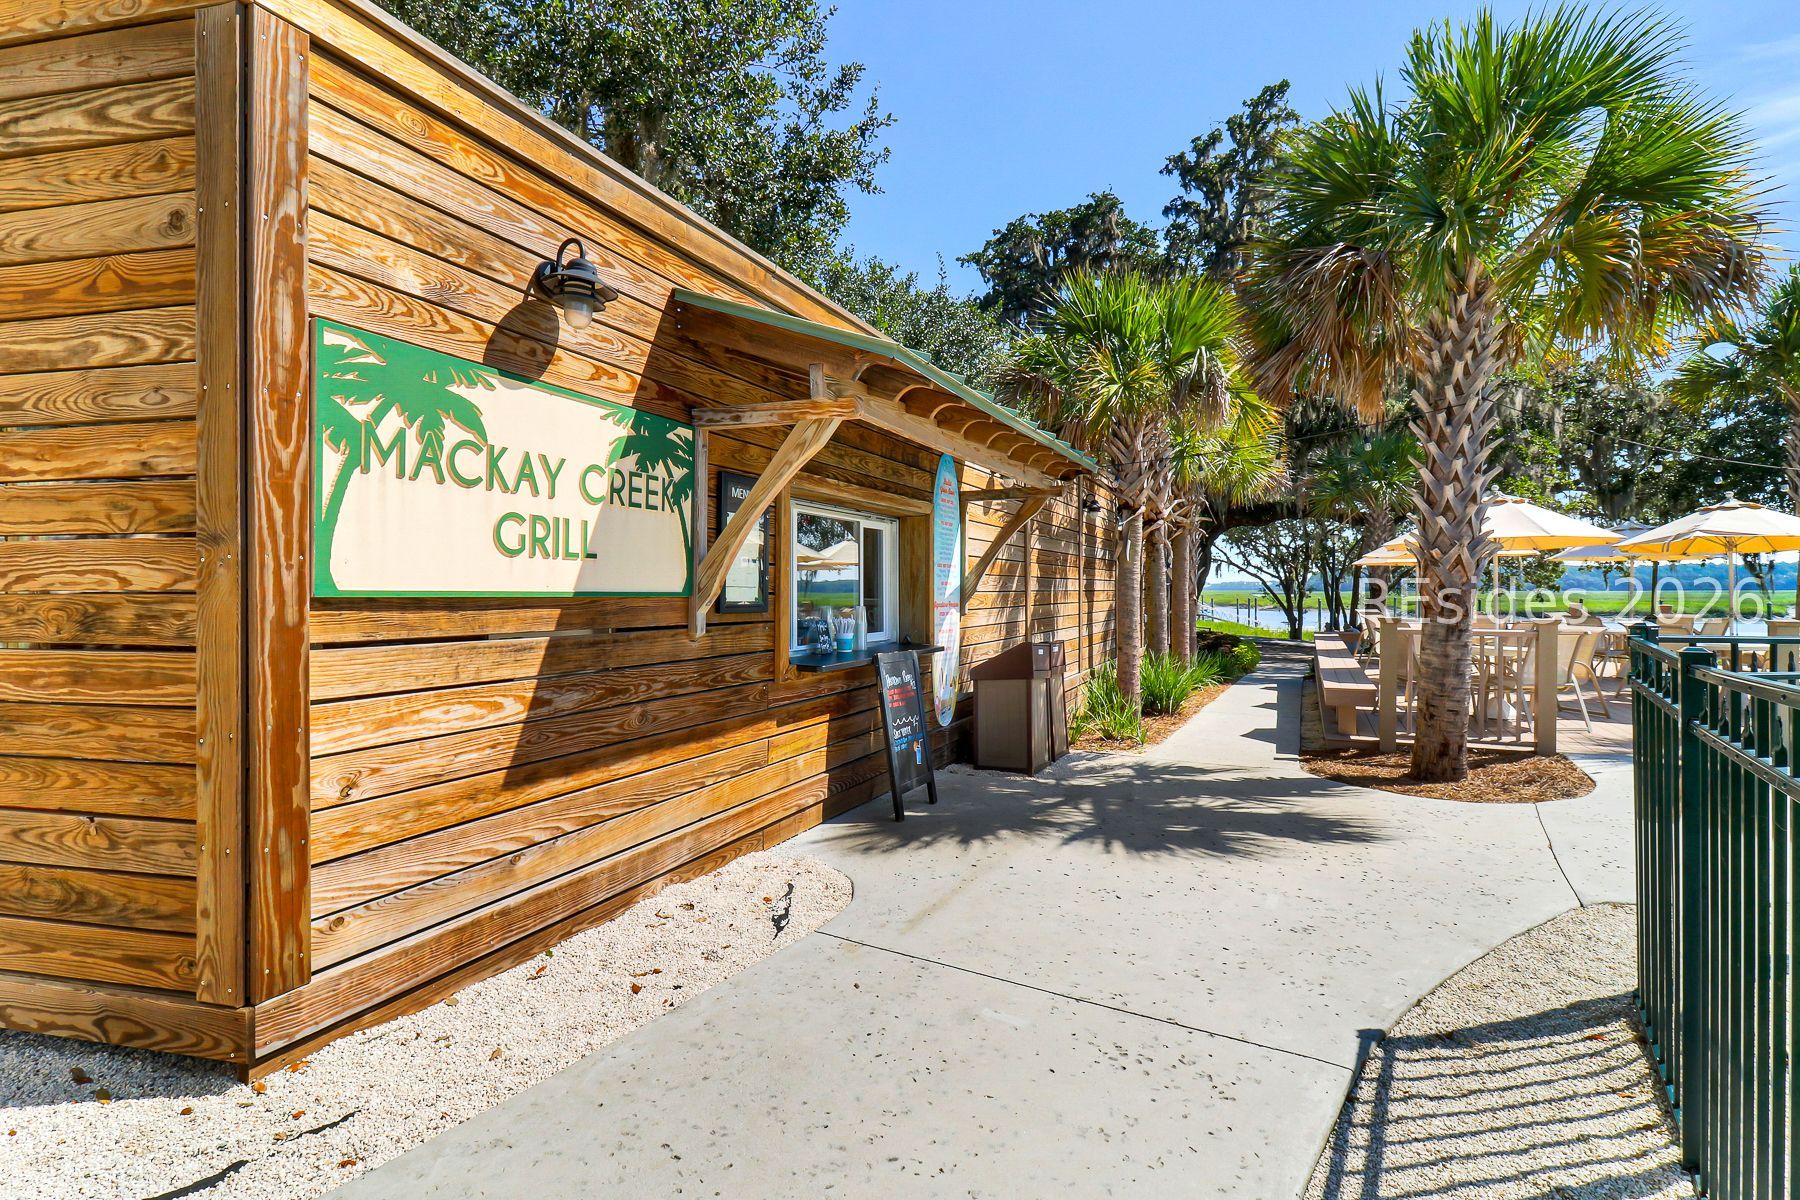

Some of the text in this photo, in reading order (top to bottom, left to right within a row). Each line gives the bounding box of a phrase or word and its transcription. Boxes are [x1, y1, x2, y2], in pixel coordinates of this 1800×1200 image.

[360, 418, 675, 513] MACKAY CREEK
[731, 486, 751, 500] MEN
[493, 511, 597, 561] GRILL
